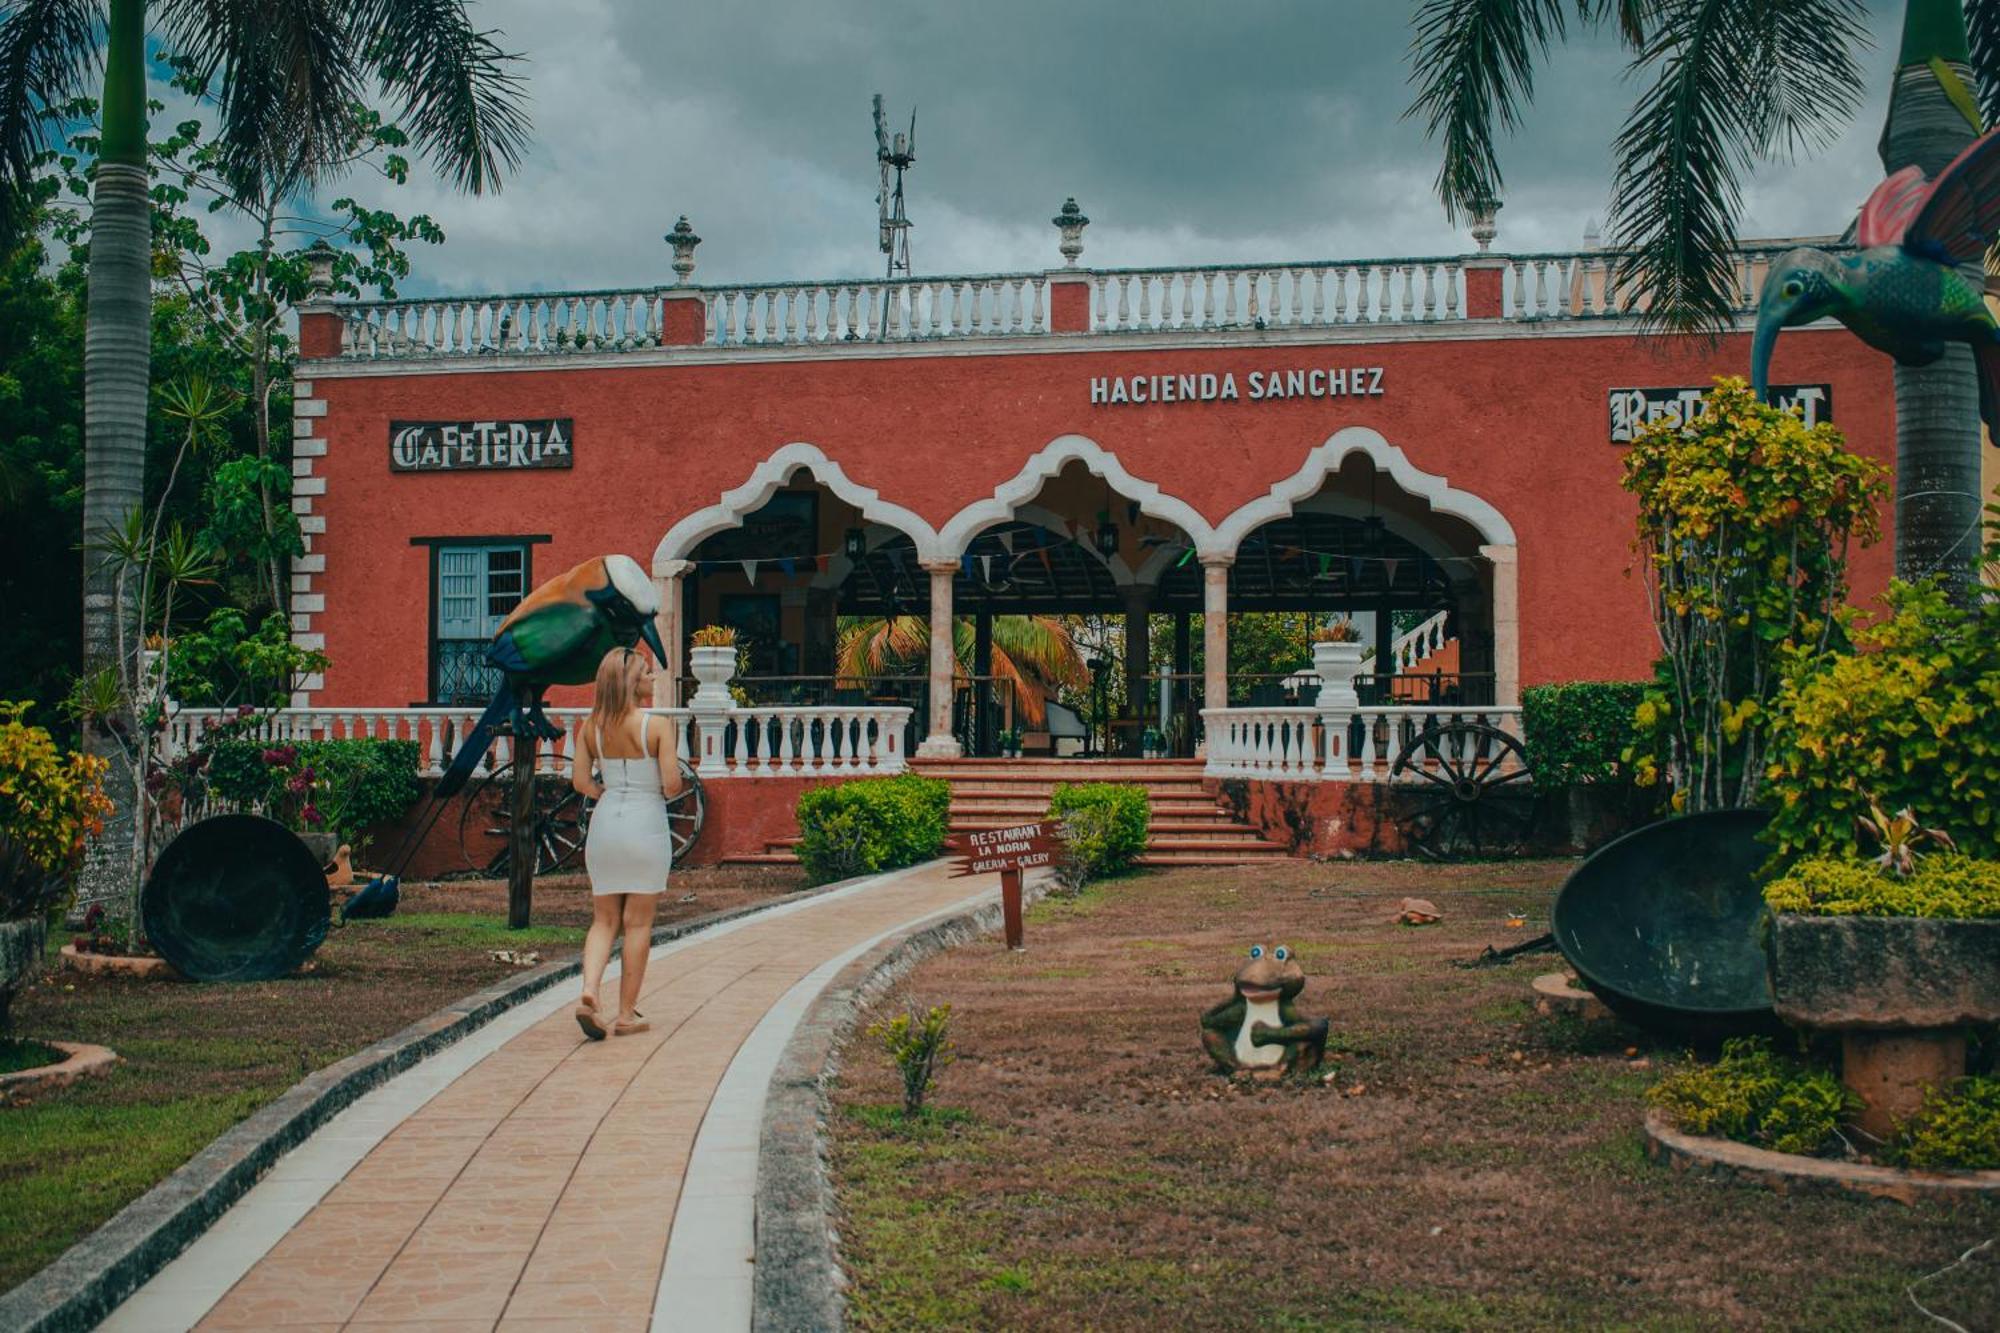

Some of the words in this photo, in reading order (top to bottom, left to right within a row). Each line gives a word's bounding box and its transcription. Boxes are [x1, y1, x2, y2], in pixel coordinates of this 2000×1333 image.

[1090, 373, 1239, 404] HACIENDA
[1248, 367, 1384, 399] SANCHEZ
[393, 419, 569, 469] CAFETERIA
[970, 825, 1041, 846] RESTAURANT
[978, 847, 991, 857] LA
[996, 841, 1031, 854] NORIA
[972, 858, 1008, 873] GALERIA
